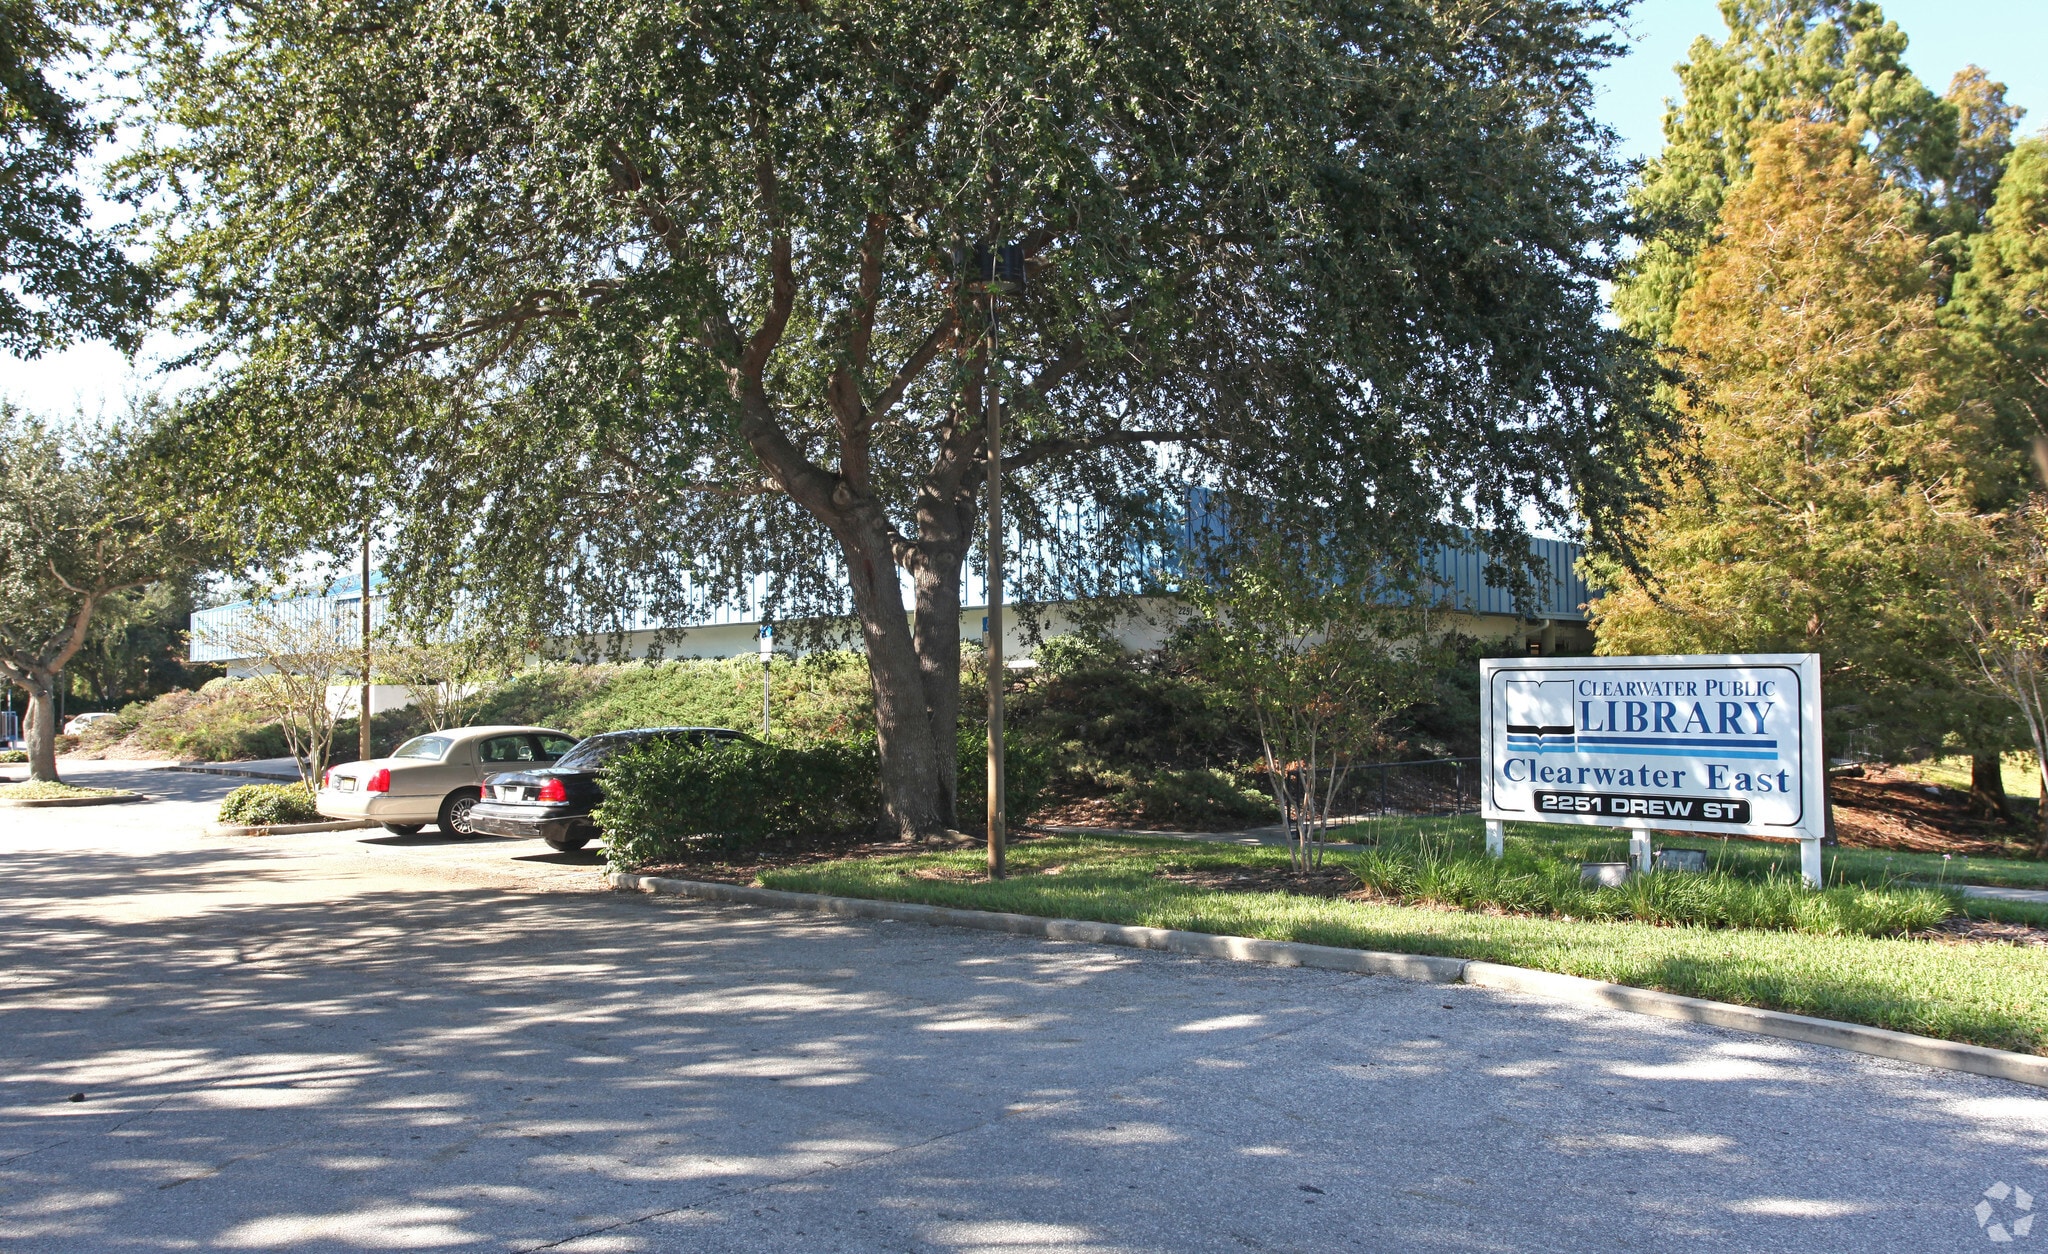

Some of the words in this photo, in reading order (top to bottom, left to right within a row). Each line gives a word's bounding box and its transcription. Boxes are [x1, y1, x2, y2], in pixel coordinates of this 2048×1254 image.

[1178, 606, 1193, 616] 2251
[1578, 679, 1697, 697] CLEARWATER
[1705, 679, 1776, 697] PUBLIC
[1578, 700, 1775, 735] LIBRARY
[1503, 758, 1686, 788] Clearwater
[1705, 763, 1791, 793] East
[1541, 794, 1603, 813] 2251
[1611, 797, 1693, 817] DREW
[1703, 802, 1740, 819] ST
